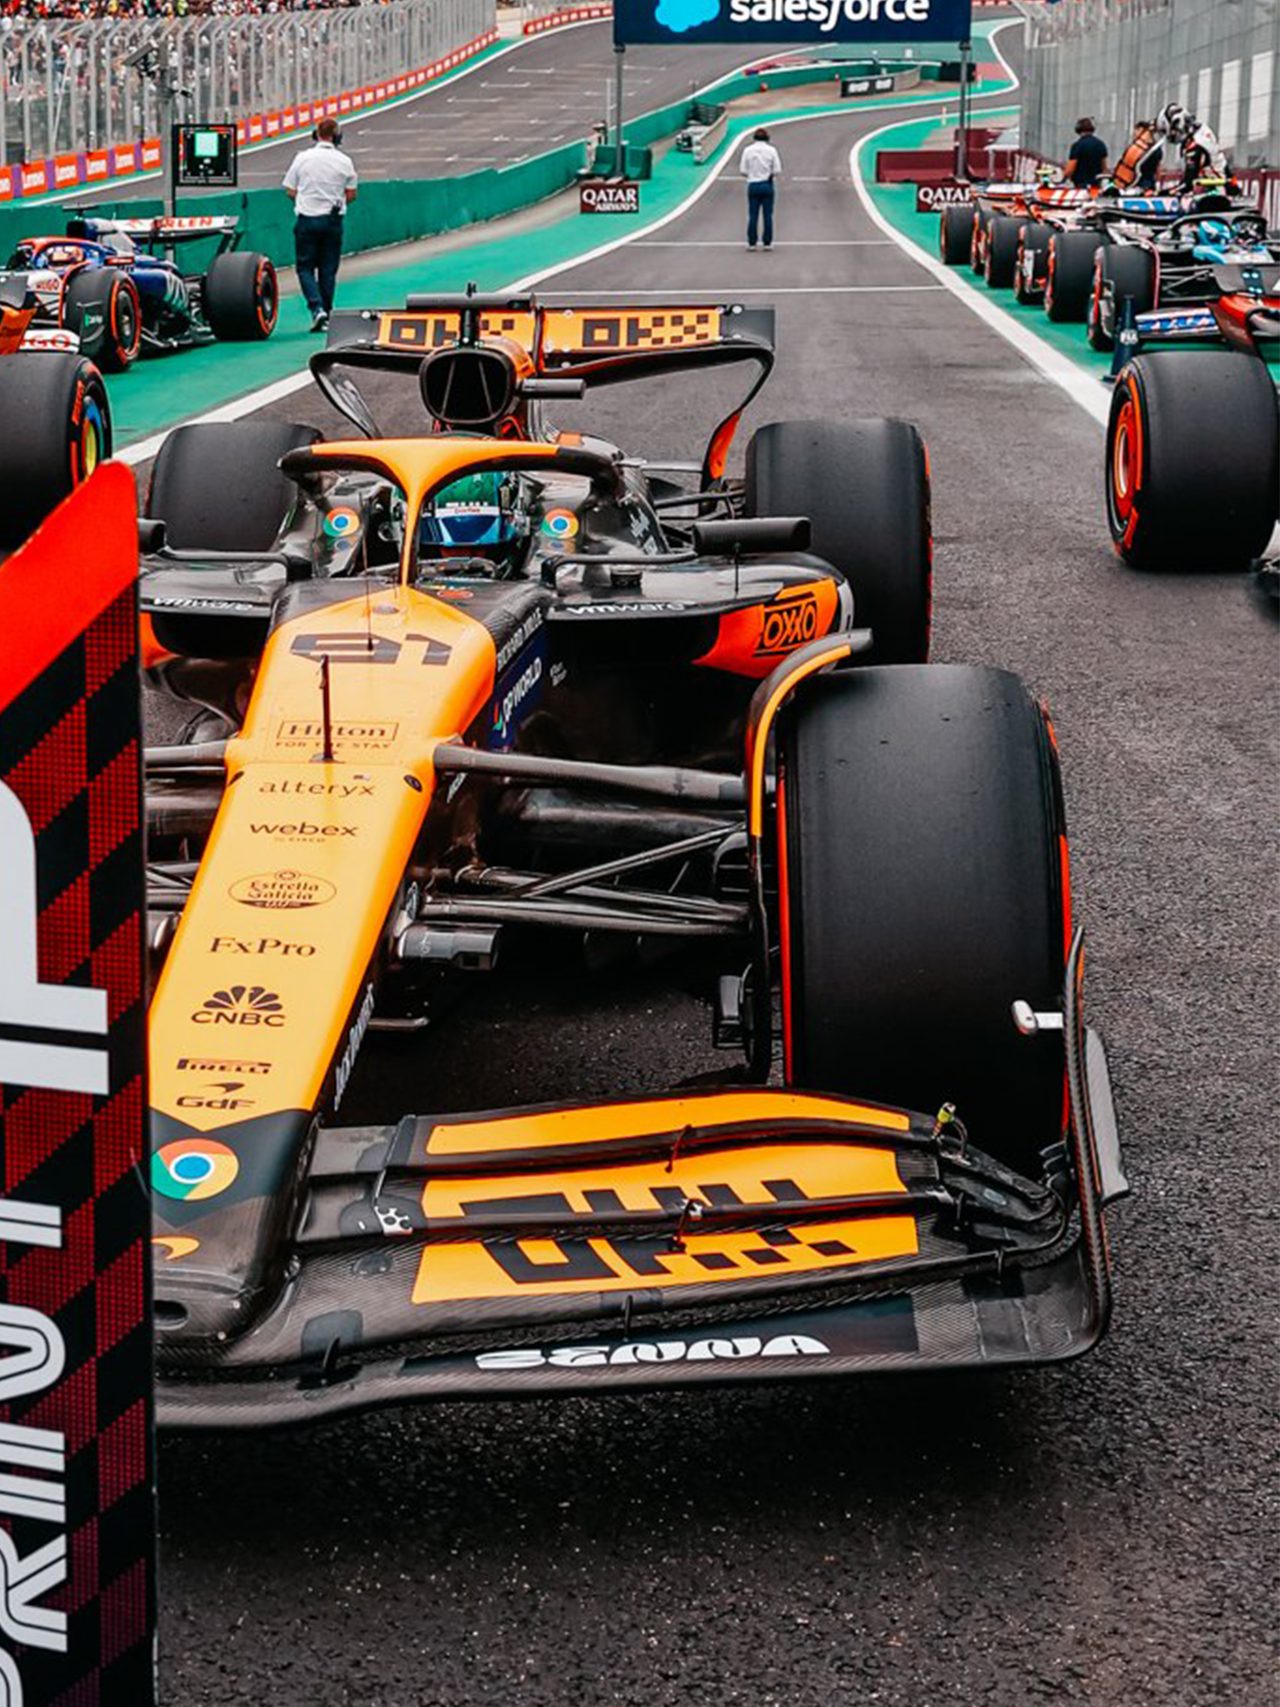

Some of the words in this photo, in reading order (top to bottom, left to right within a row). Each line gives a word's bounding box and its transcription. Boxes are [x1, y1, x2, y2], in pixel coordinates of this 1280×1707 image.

[730, 0, 928, 31] salesforce
[582, 188, 637, 205] QATAR
[567, 600, 687, 615] vmware
[763, 601, 818, 649] OXXO
[290, 632, 453, 666] 81
[512, 656, 542, 706] WORLD
[259, 780, 375, 798] alteryx
[250, 821, 359, 836] webex
[248, 890, 312, 900] Galicia
[251, 881, 319, 892] Estrella
[209, 937, 317, 957] FxPro
[191, 1011, 287, 1028] CNBC
[176, 1058, 272, 1075] PIRELLI
[475, 1335, 831, 1370] SENNA
